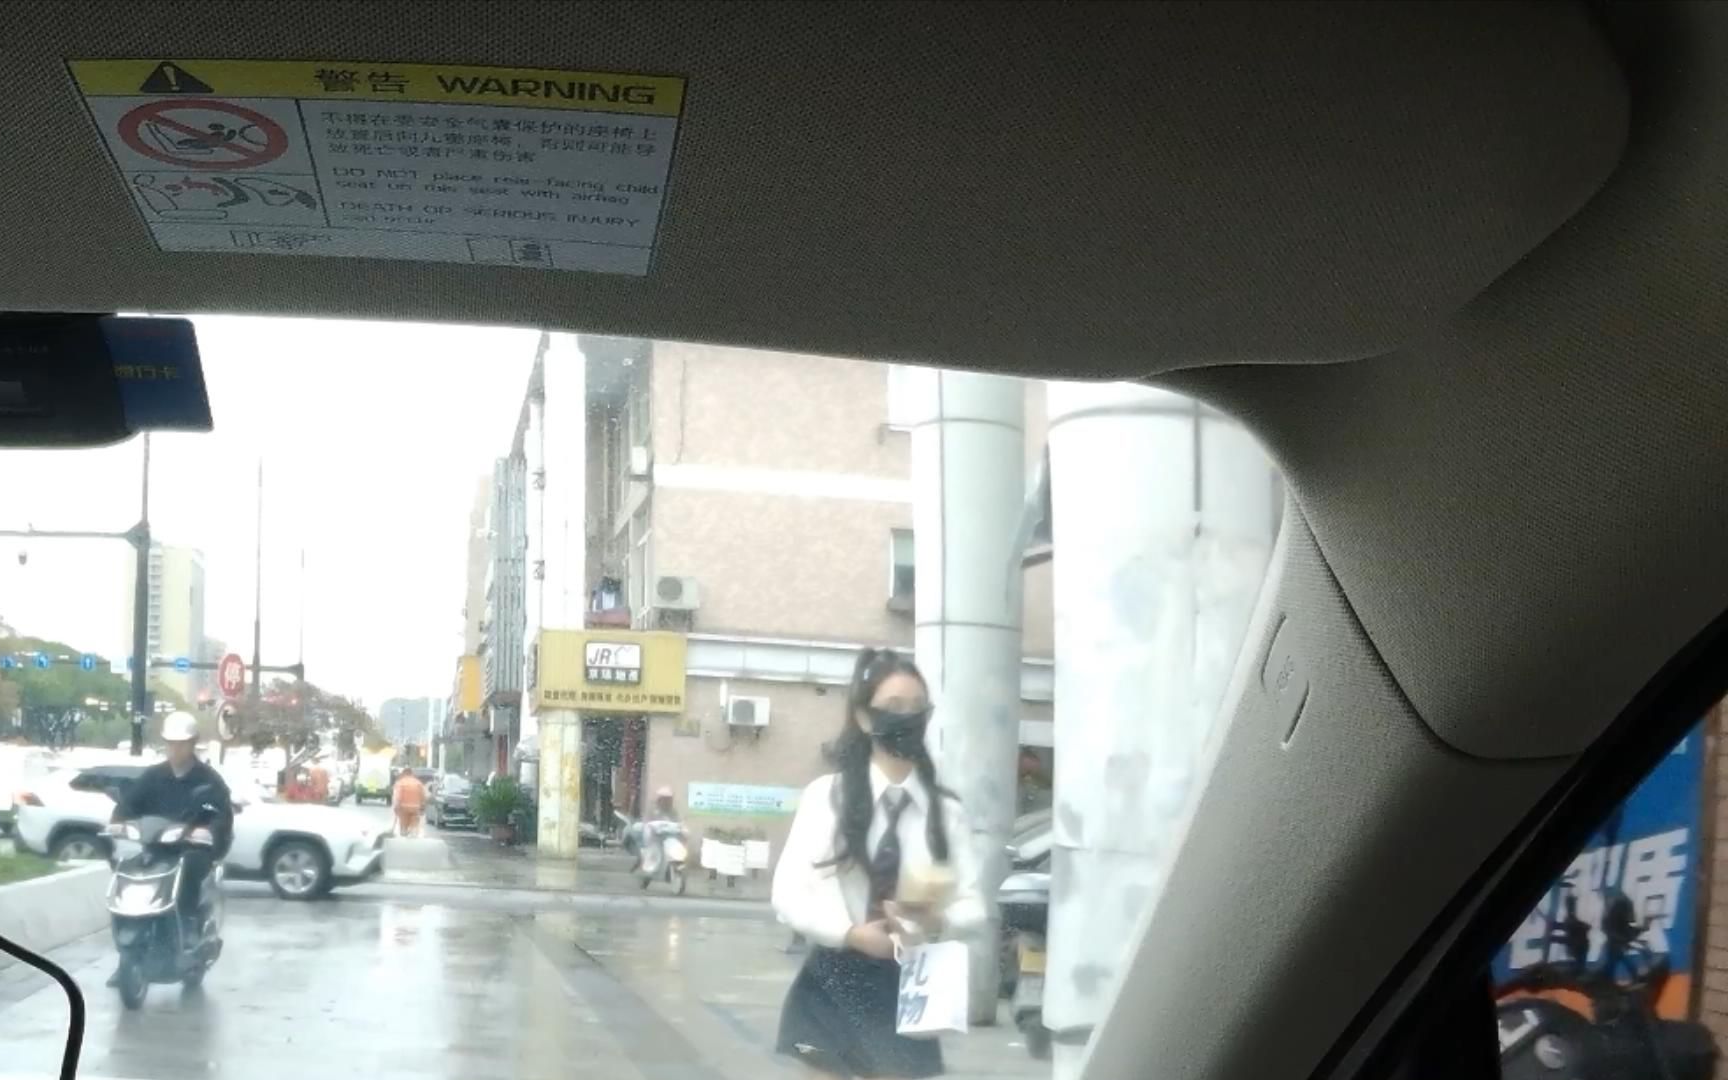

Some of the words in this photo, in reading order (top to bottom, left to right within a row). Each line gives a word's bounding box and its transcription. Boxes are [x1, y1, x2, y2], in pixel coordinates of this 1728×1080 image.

[315, 68, 410, 94] 警告
[436, 73, 656, 105] WARNING
[377, 169, 417, 179] NOT
[589, 647, 612, 665] JR
